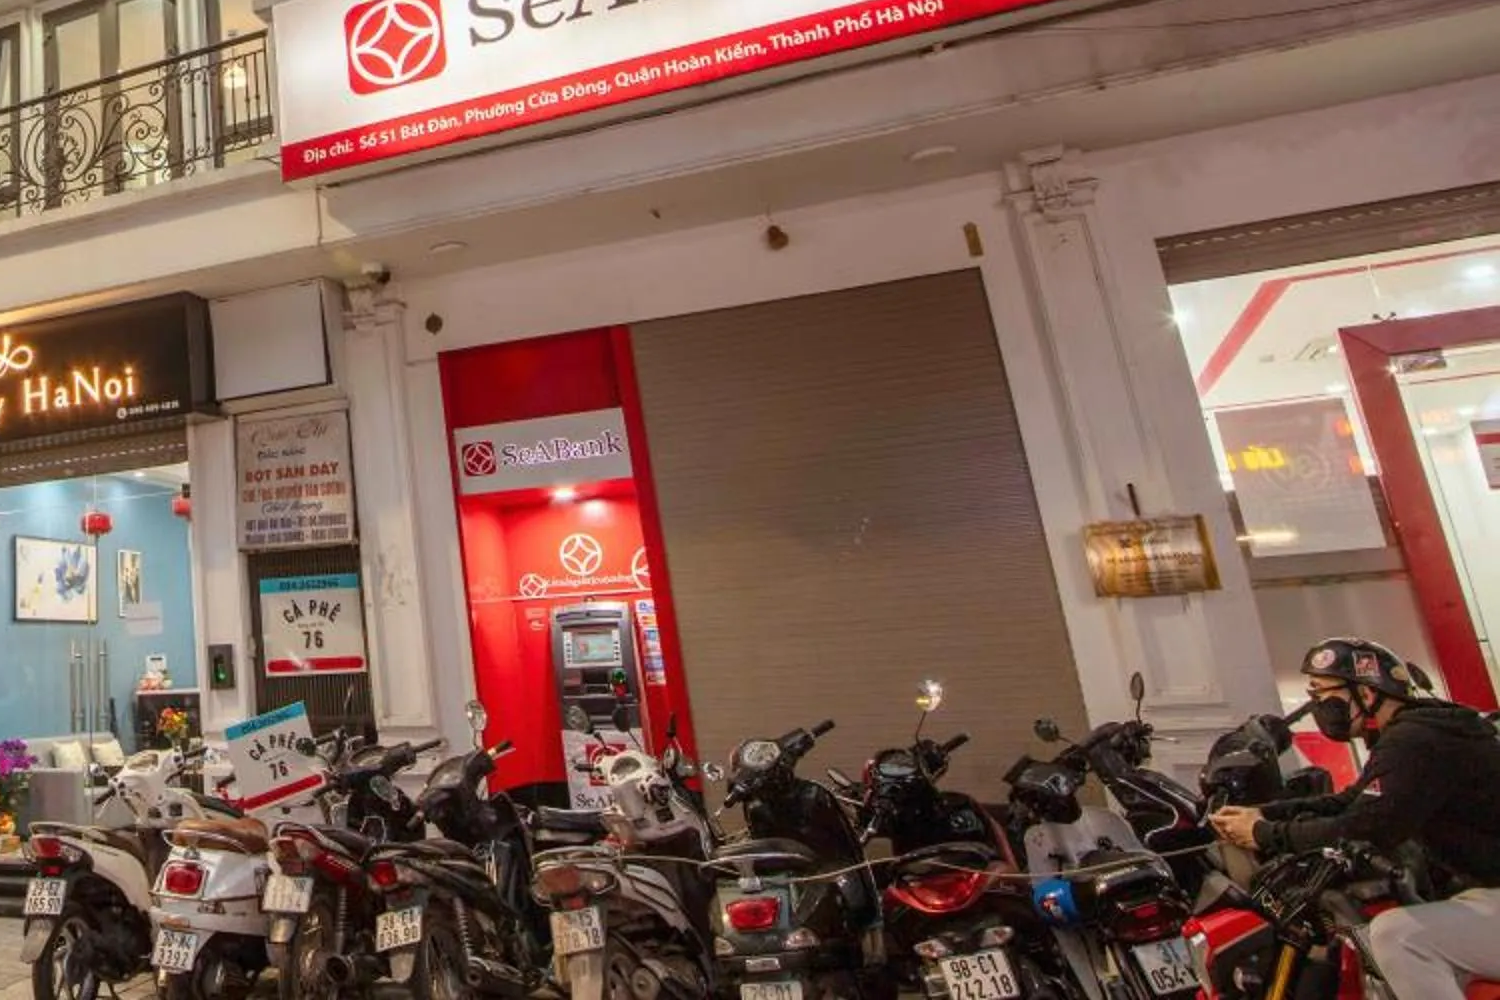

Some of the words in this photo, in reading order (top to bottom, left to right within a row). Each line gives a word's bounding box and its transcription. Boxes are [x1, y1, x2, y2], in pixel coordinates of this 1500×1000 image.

[378, 130, 397, 145] 51
[663, 54, 712, 77] Hoàn
[768, 23, 830, 50] Thành
[833, 11, 873, 36] Phố
[875, 5, 905, 25] Hà
[22, 366, 137, 414] HaNoi
[502, 429, 624, 466] SeABank
[302, 630, 324, 648] 76
[268, 760, 288, 780] 76
[950, 954, 999, 979] 98-C1
